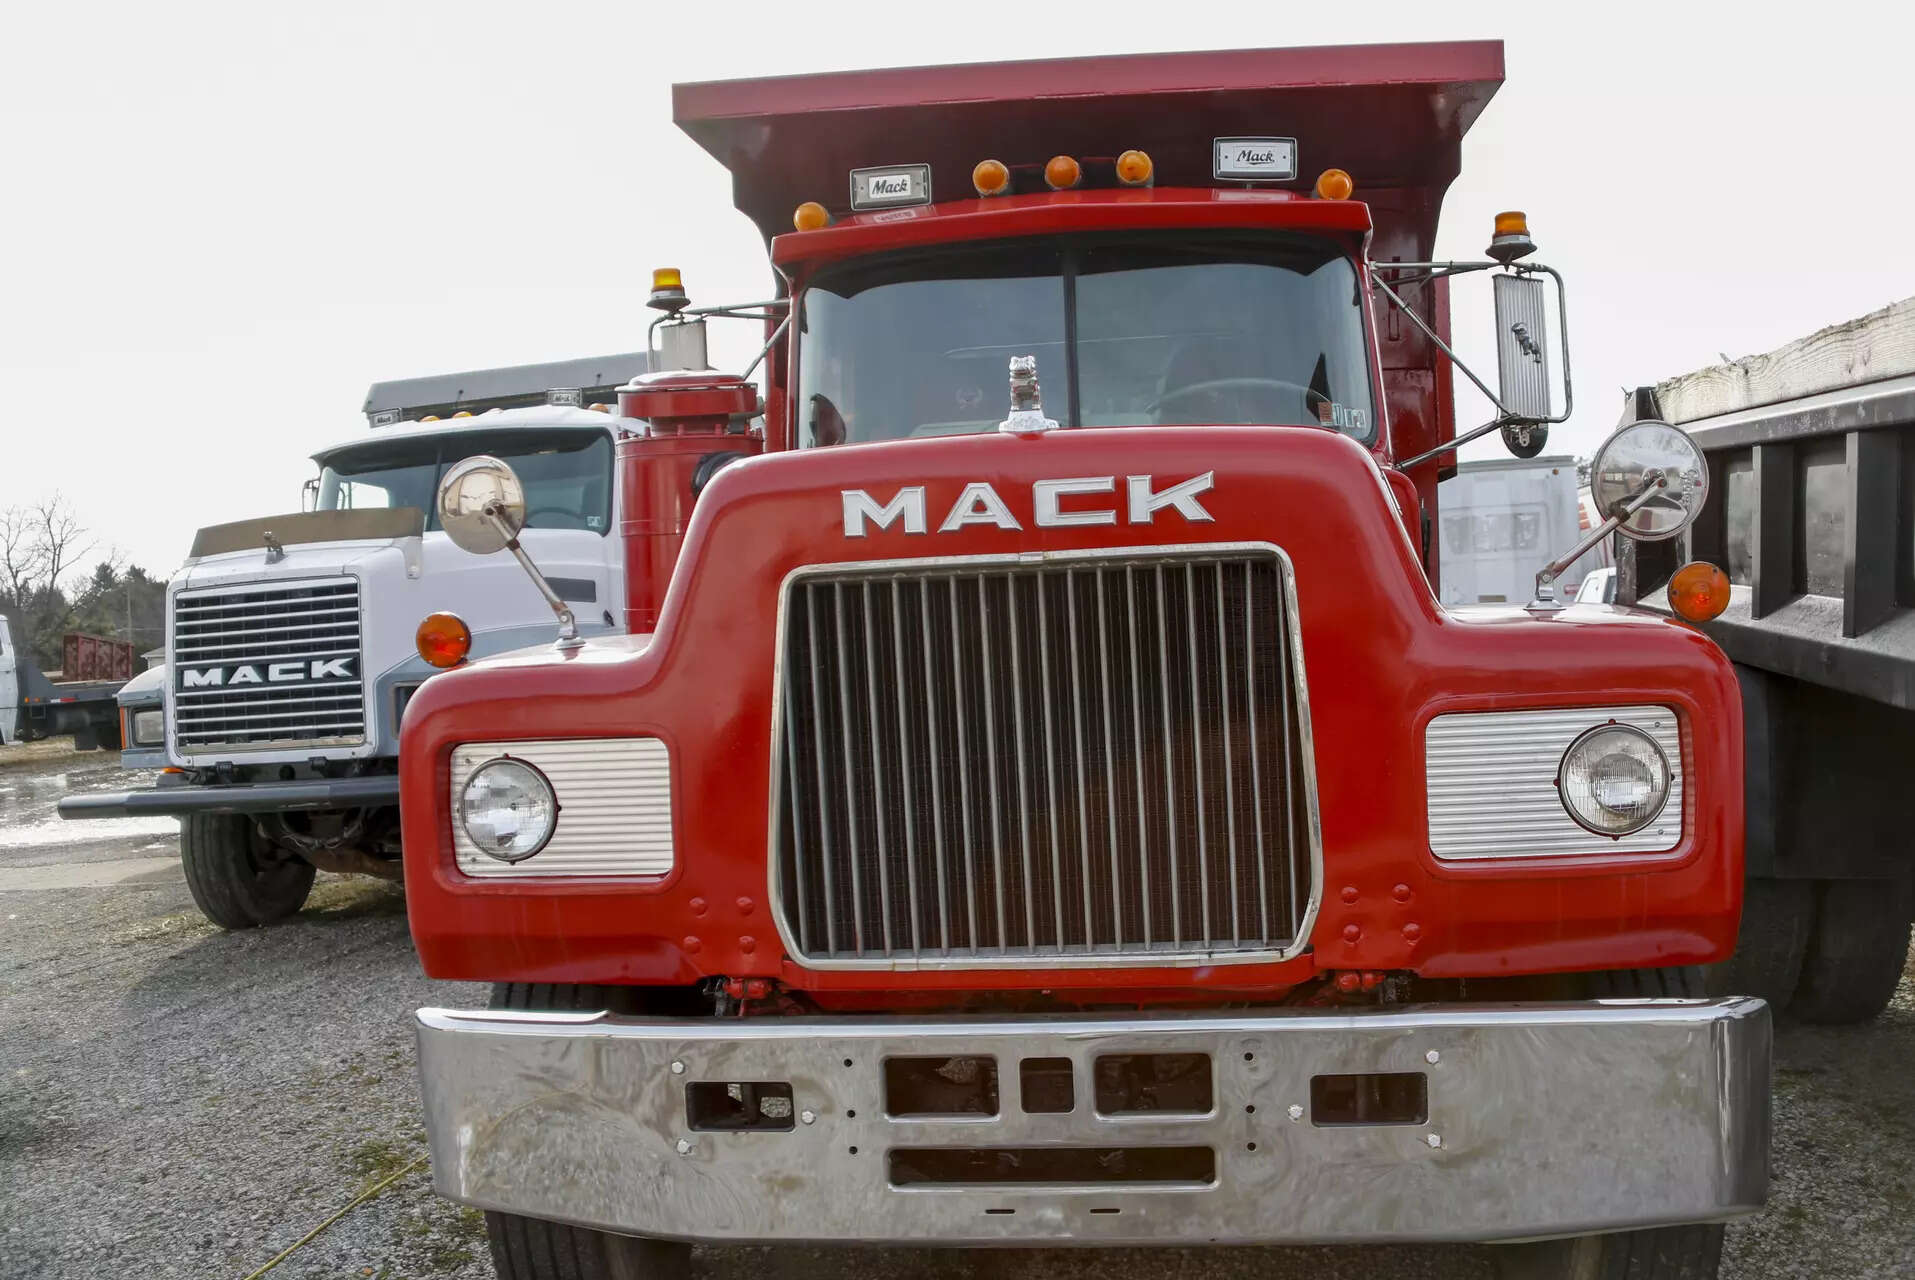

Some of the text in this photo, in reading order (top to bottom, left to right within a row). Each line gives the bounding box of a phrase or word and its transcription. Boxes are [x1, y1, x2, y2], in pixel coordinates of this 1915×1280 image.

[1235, 149, 1275, 163] Mack
[872, 179, 908, 195] Mack
[841, 470, 1216, 538] MACK
[183, 657, 353, 688] MACK
